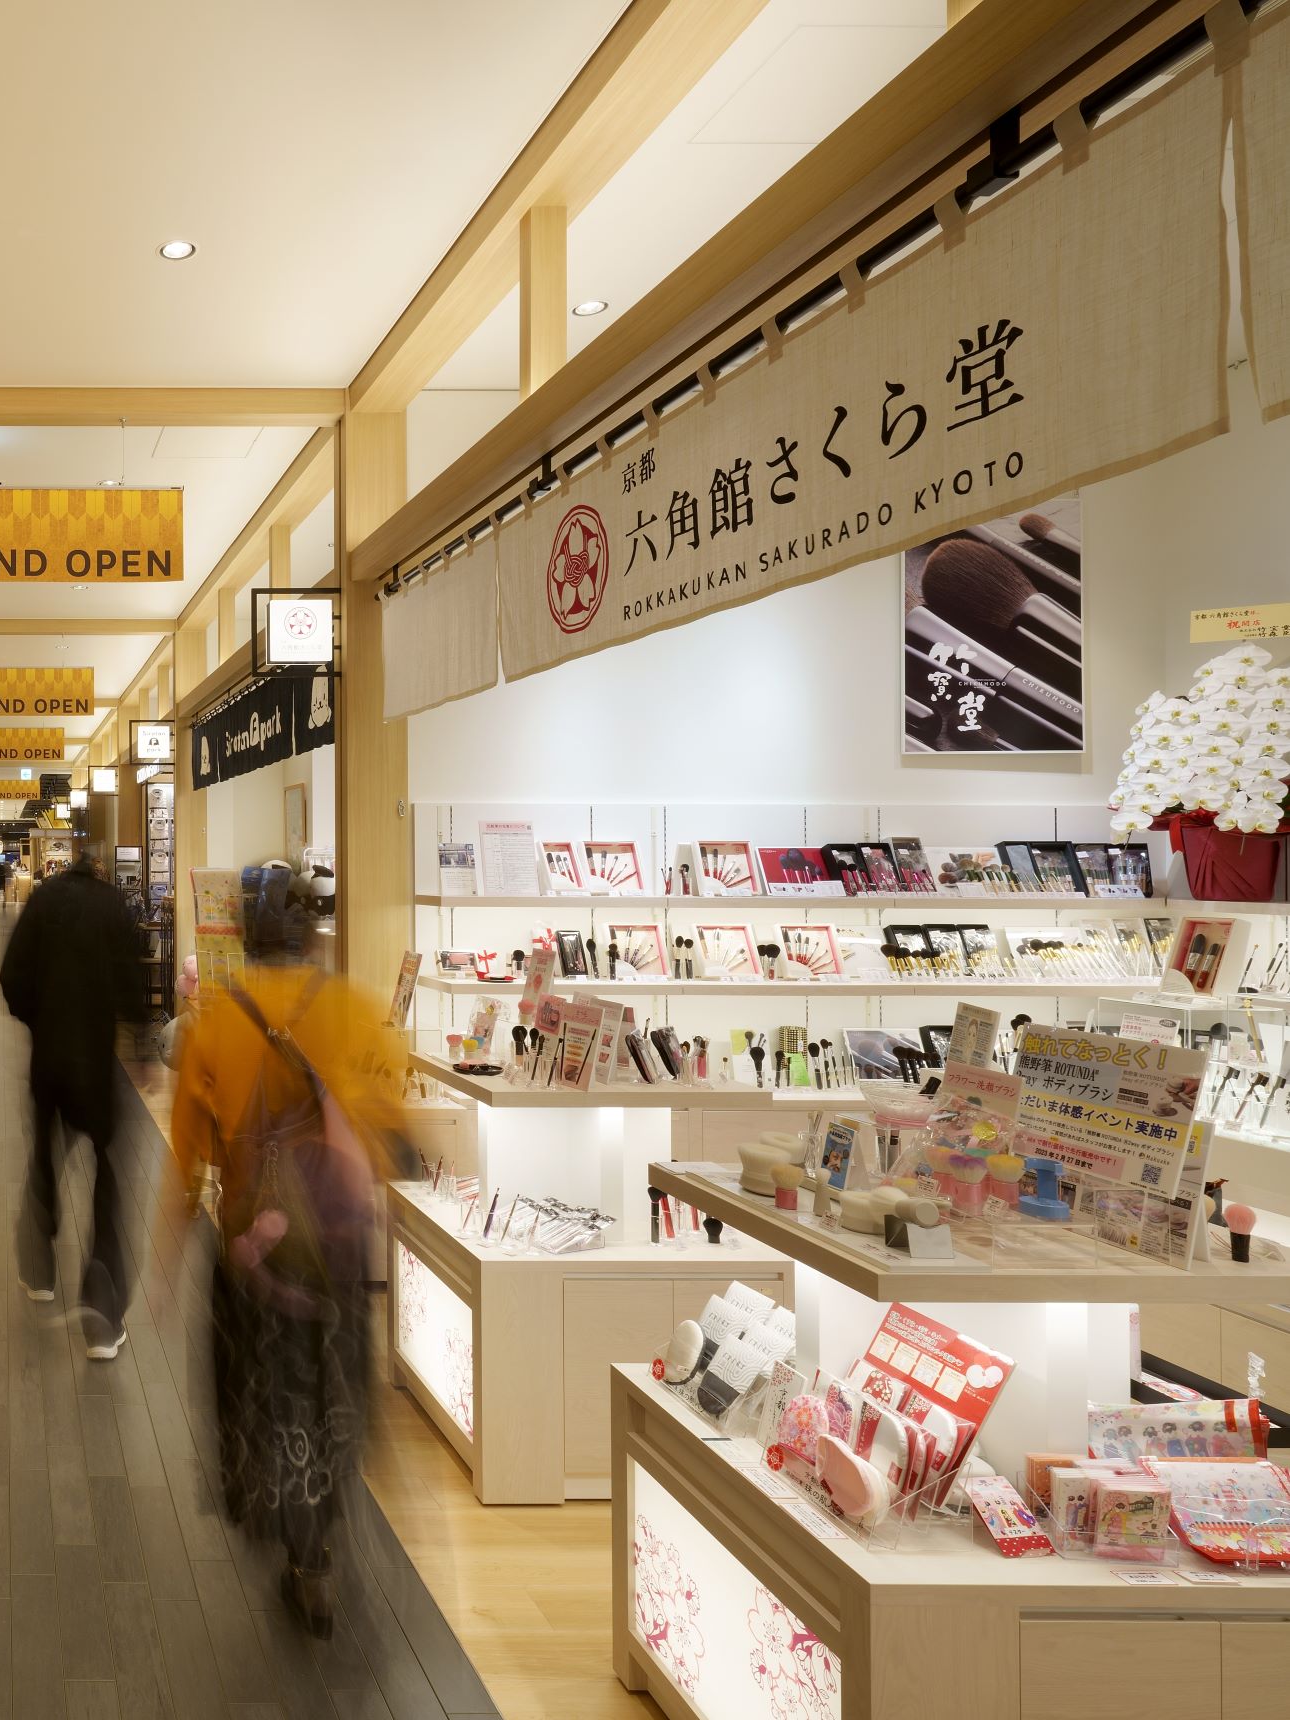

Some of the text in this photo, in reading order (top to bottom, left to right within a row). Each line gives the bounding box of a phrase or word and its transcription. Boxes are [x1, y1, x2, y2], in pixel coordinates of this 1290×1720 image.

[623, 318, 1025, 577] 六角館さくら堂
[621, 447, 657, 495] 京都
[623, 451, 1025, 621] ROKKAKUKAN SAKURADO KYOTO
[66, 549, 172, 577] OPEN
[34, 698, 89, 714] OPEN
[1021, 677, 1081, 715] CHIKUHODO
[23, 748, 61, 759] OPEN
[1018, 1055, 1053, 1073] 熊野筆
[1022, 1032, 1168, 1071] 触れてなっとく！
[1043, 1076, 1114, 1102] ボディブラシ
[1017, 1094, 1178, 1143] だいま体感イベント実施中
